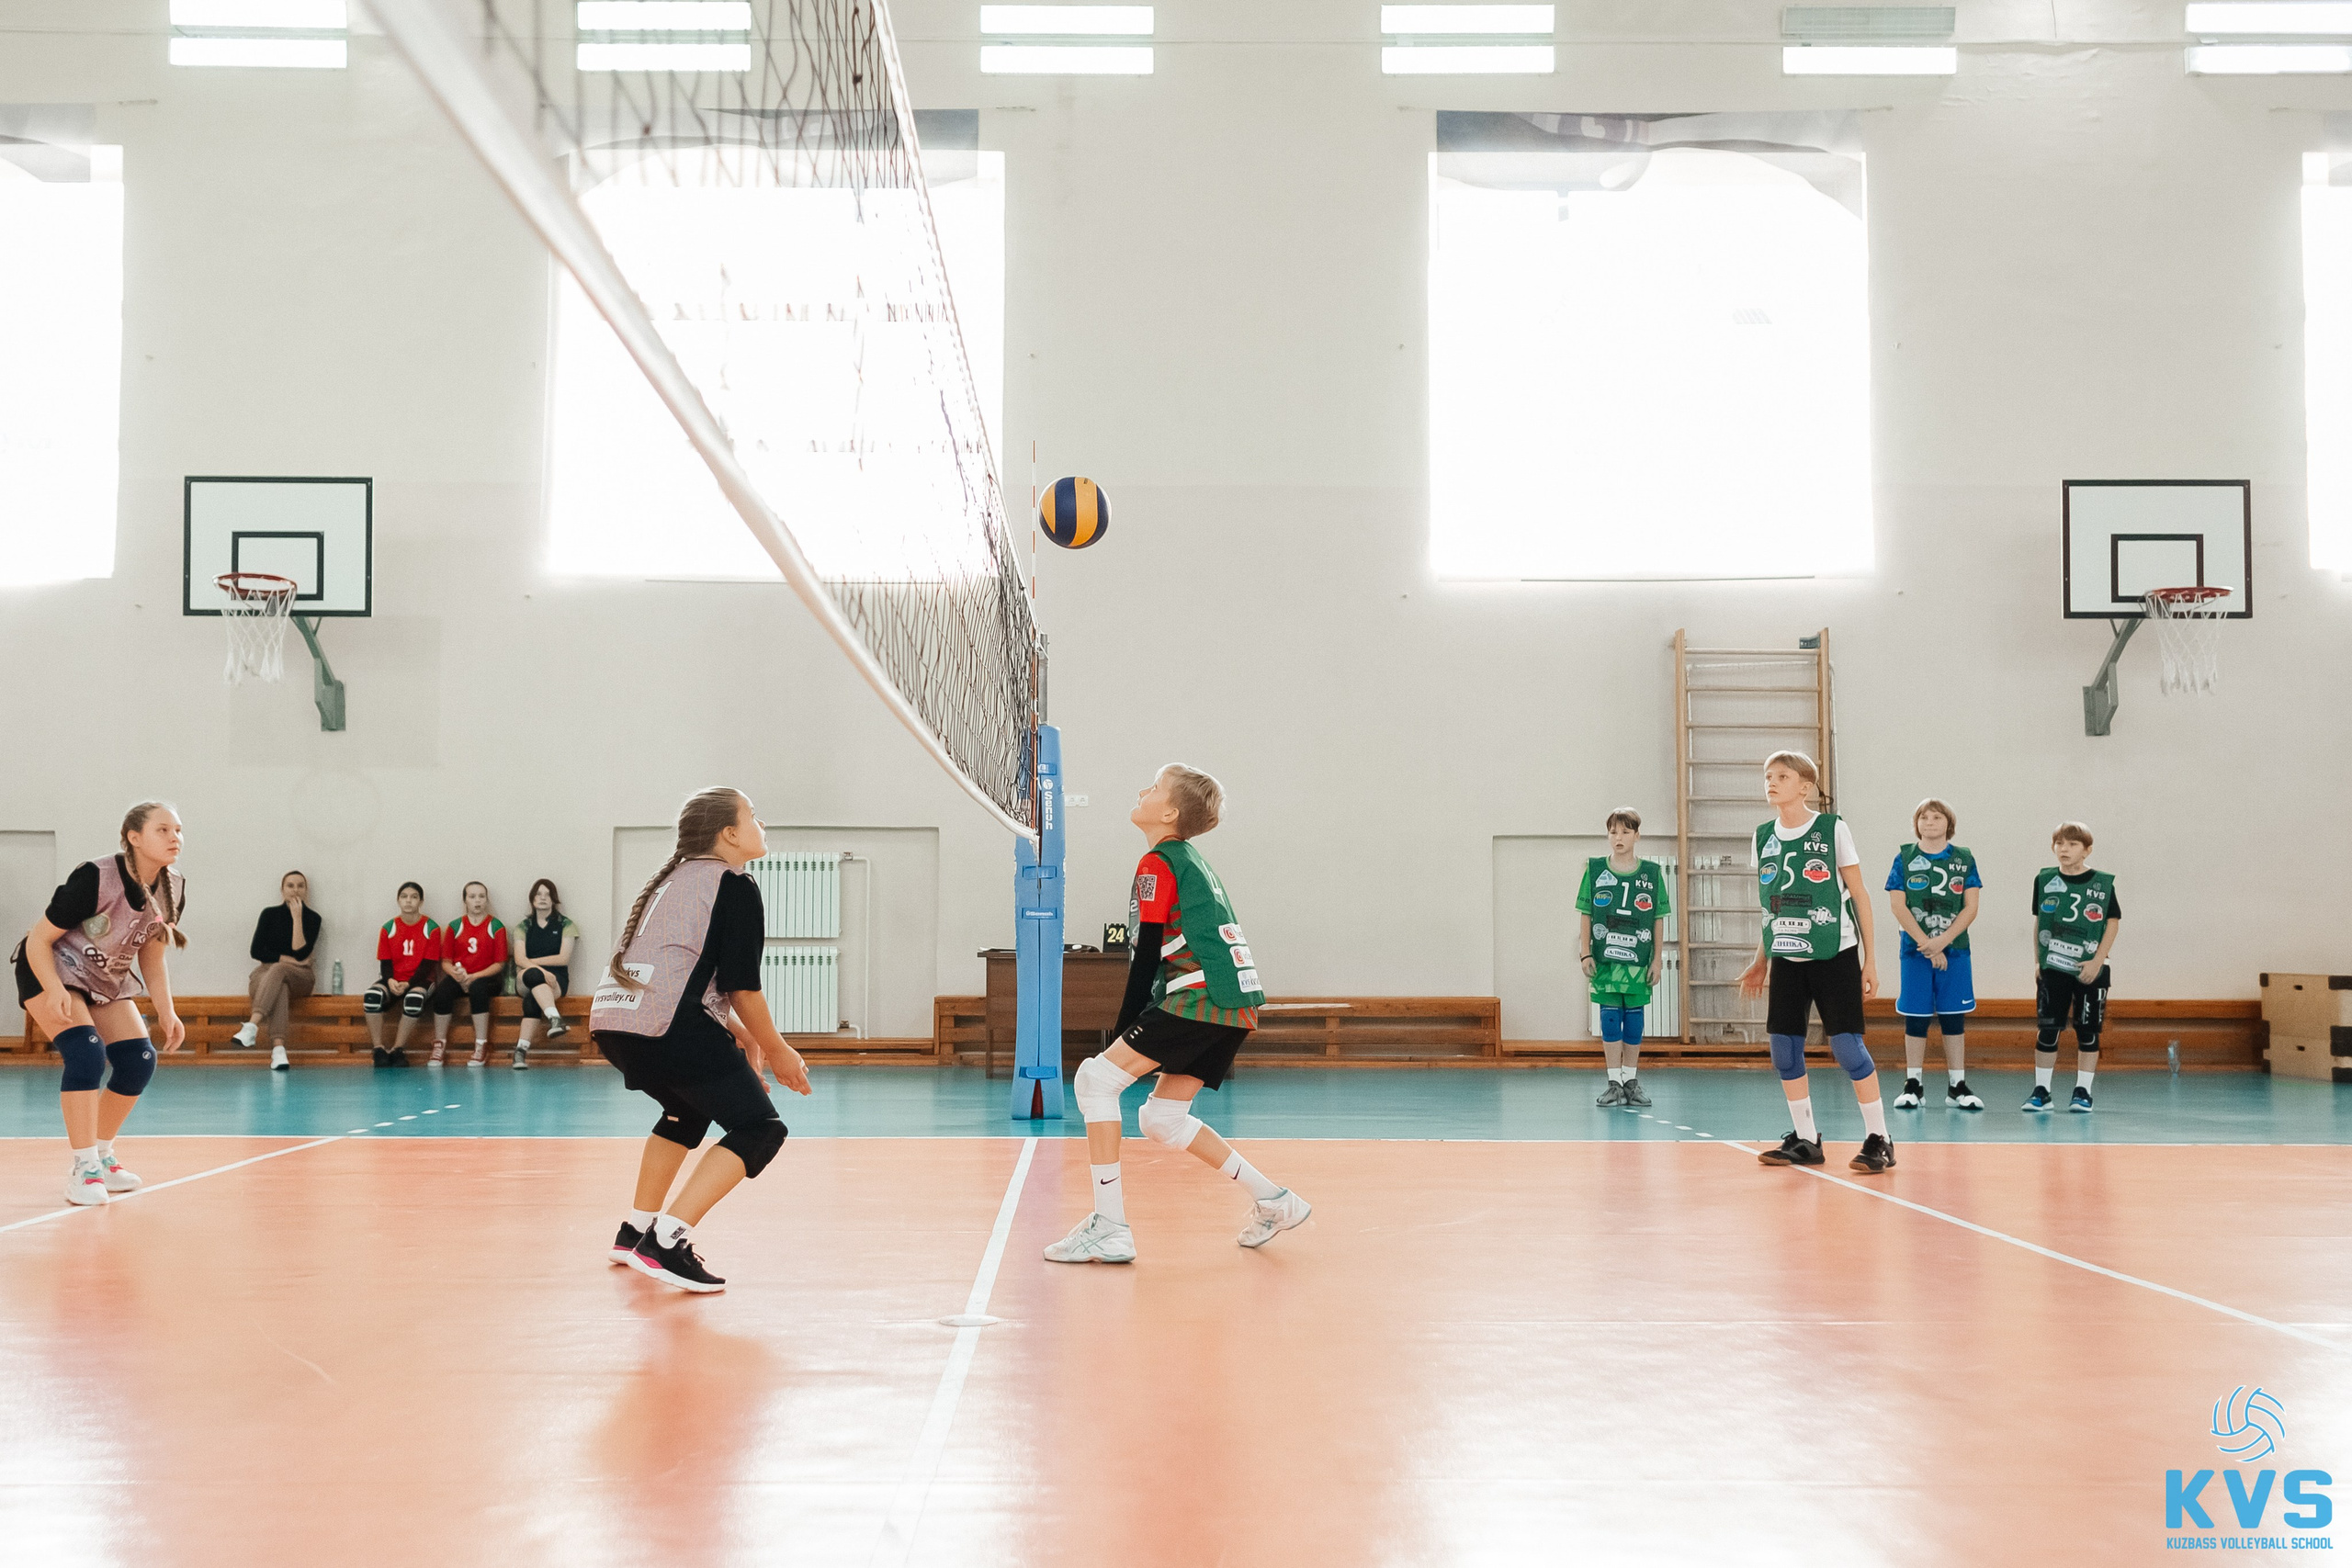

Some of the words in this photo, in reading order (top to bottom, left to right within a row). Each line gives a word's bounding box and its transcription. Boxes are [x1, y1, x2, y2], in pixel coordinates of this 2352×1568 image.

[1804, 840, 1829, 853] KVS
[1781, 851, 1797, 892] 5
[1635, 879, 1654, 889] KVS
[1930, 865, 1949, 897] 2
[1622, 881, 1630, 908] 1
[2086, 887, 2106, 900] KVS
[637, 879, 673, 939] 1
[2062, 893, 2082, 922] 3
[1107, 927, 1125, 943] 24
[402, 939, 414, 956] 11
[467, 937, 478, 954] 3
